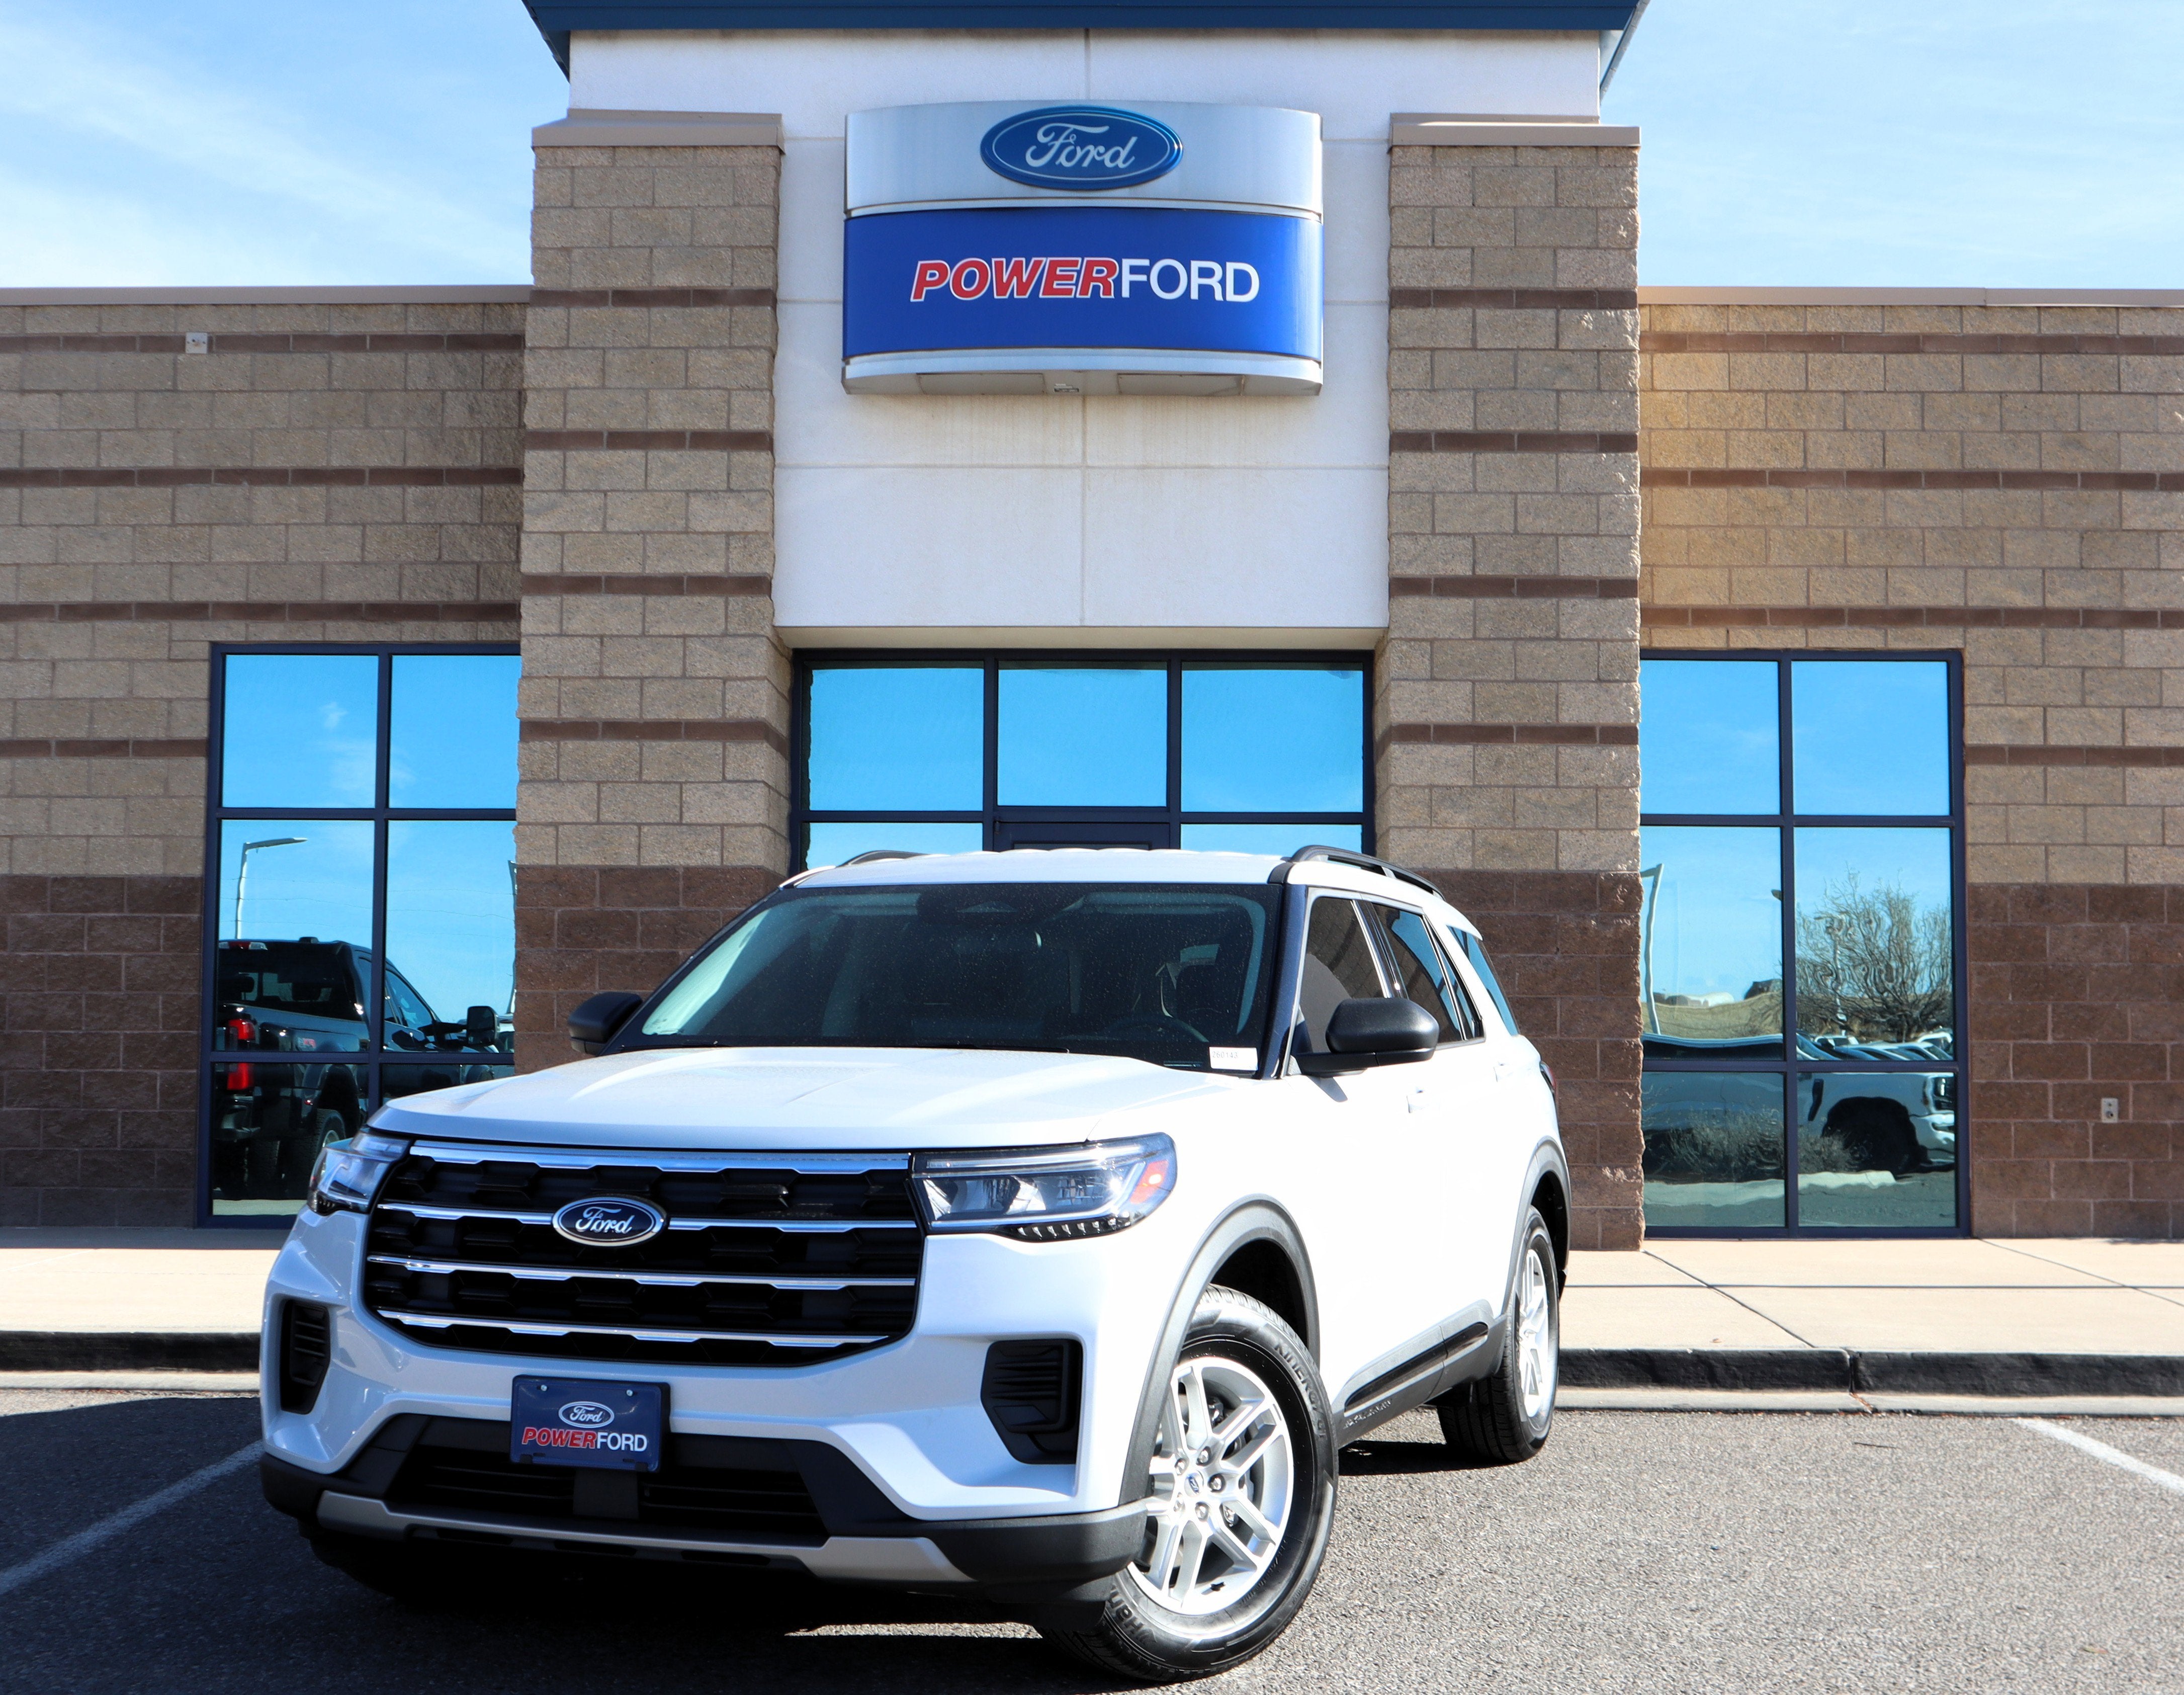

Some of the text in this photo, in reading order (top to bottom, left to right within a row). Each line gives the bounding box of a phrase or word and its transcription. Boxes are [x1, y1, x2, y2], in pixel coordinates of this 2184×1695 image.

[1025, 123, 1138, 168] Ford
[1212, 1051, 1238, 1059] 260143
[575, 1206, 635, 1234] Ford
[569, 1405, 603, 1423] Ford
